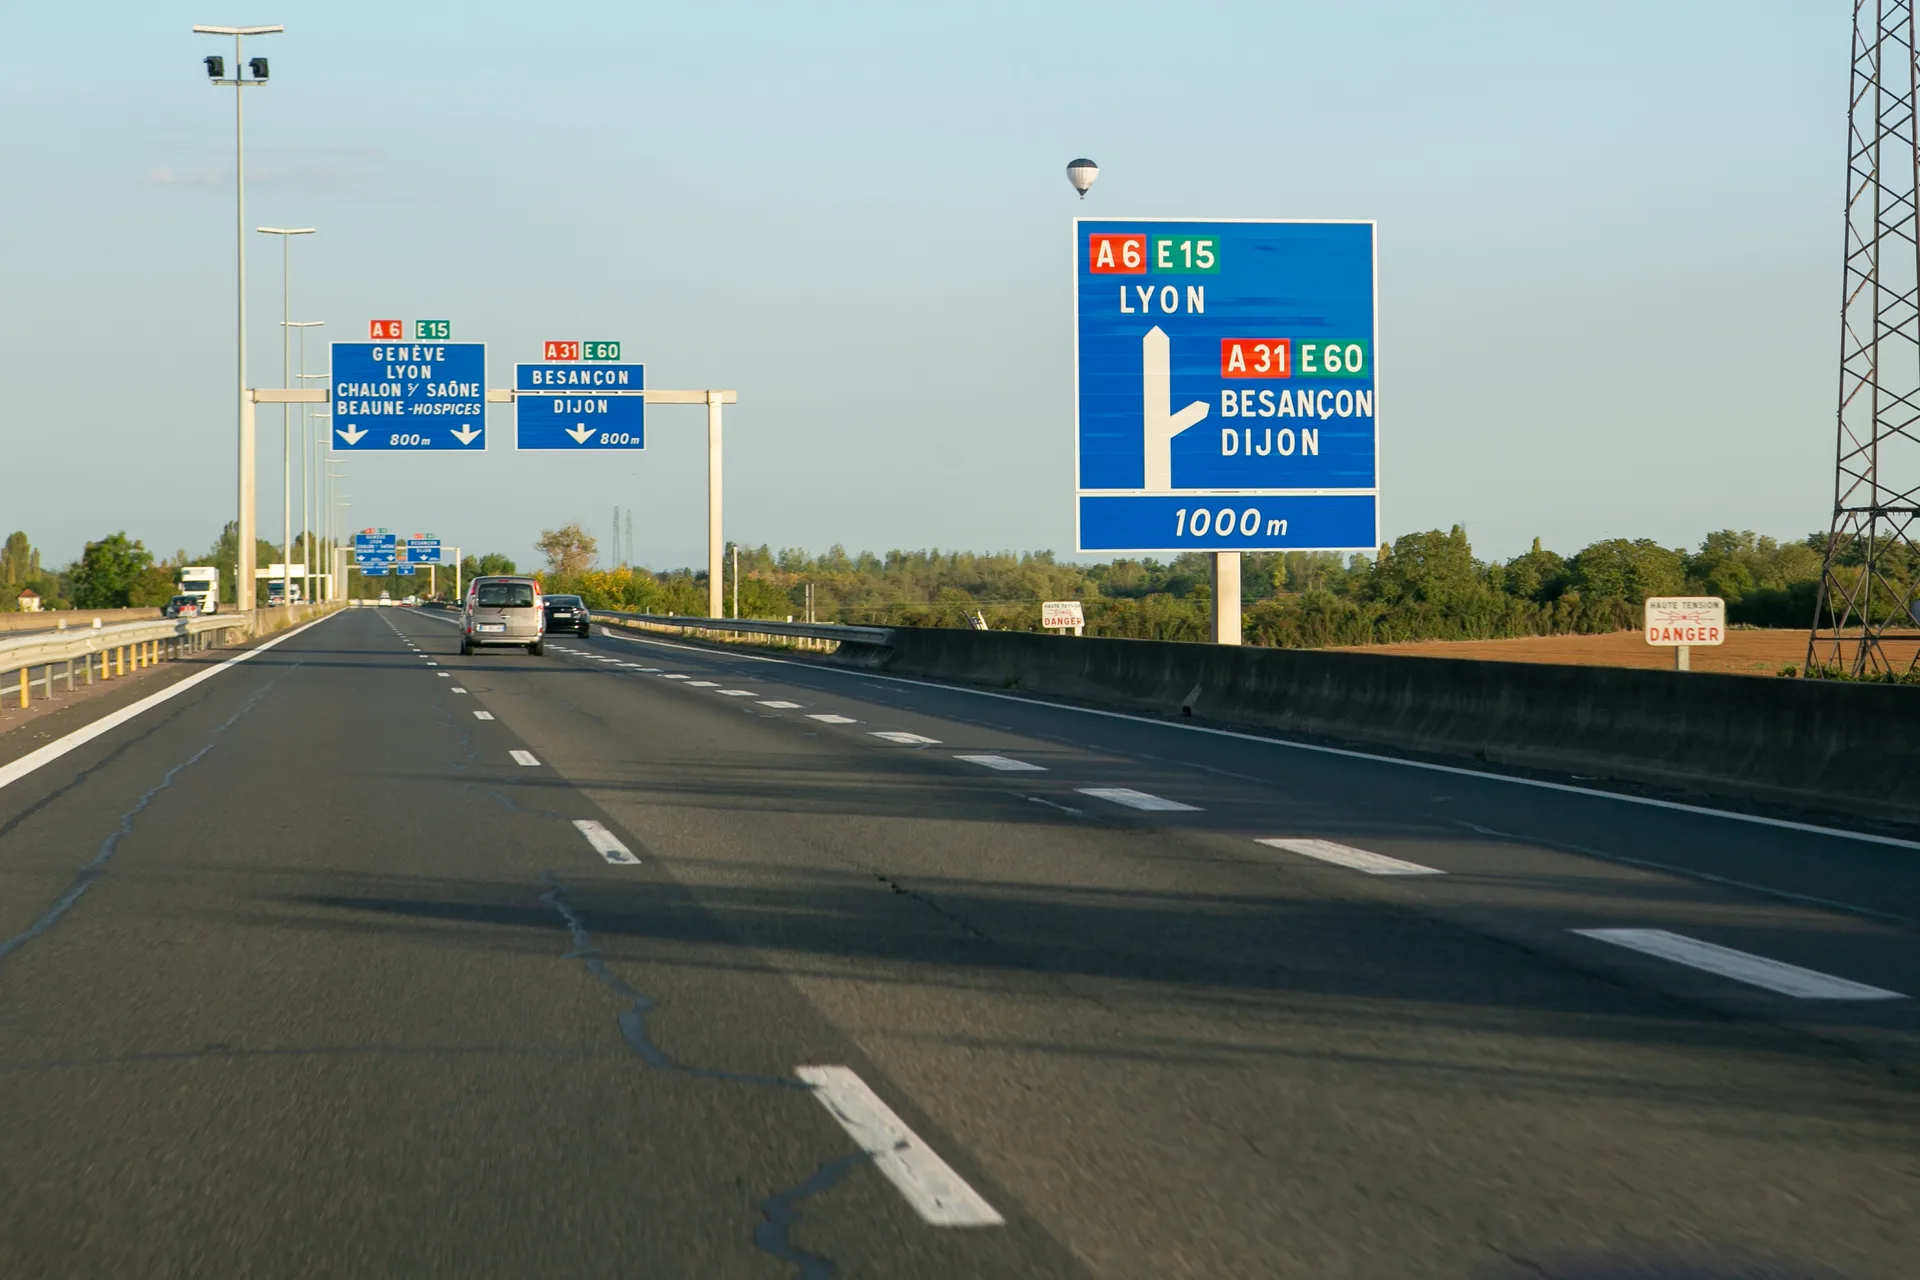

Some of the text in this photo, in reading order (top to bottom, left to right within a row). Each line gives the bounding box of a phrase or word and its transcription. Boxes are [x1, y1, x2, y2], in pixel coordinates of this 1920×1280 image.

[1120, 285, 1205, 314] LYON
[372, 345, 445, 362] GENÈVE
[386, 365, 432, 380] LYON
[532, 370, 629, 386] BESANÇON
[337, 383, 401, 398] CHALON
[427, 380, 480, 398] SAÔNE
[337, 400, 405, 415] BEAUNE
[554, 399, 608, 414] DIJON
[1221, 389, 1373, 420] BESANÇON
[1221, 428, 1319, 456] DIJON
[1650, 601, 1720, 609] HAUTE TENSION
[1044, 617, 1082, 626] DANGER
[1650, 627, 1719, 641] DANGER
